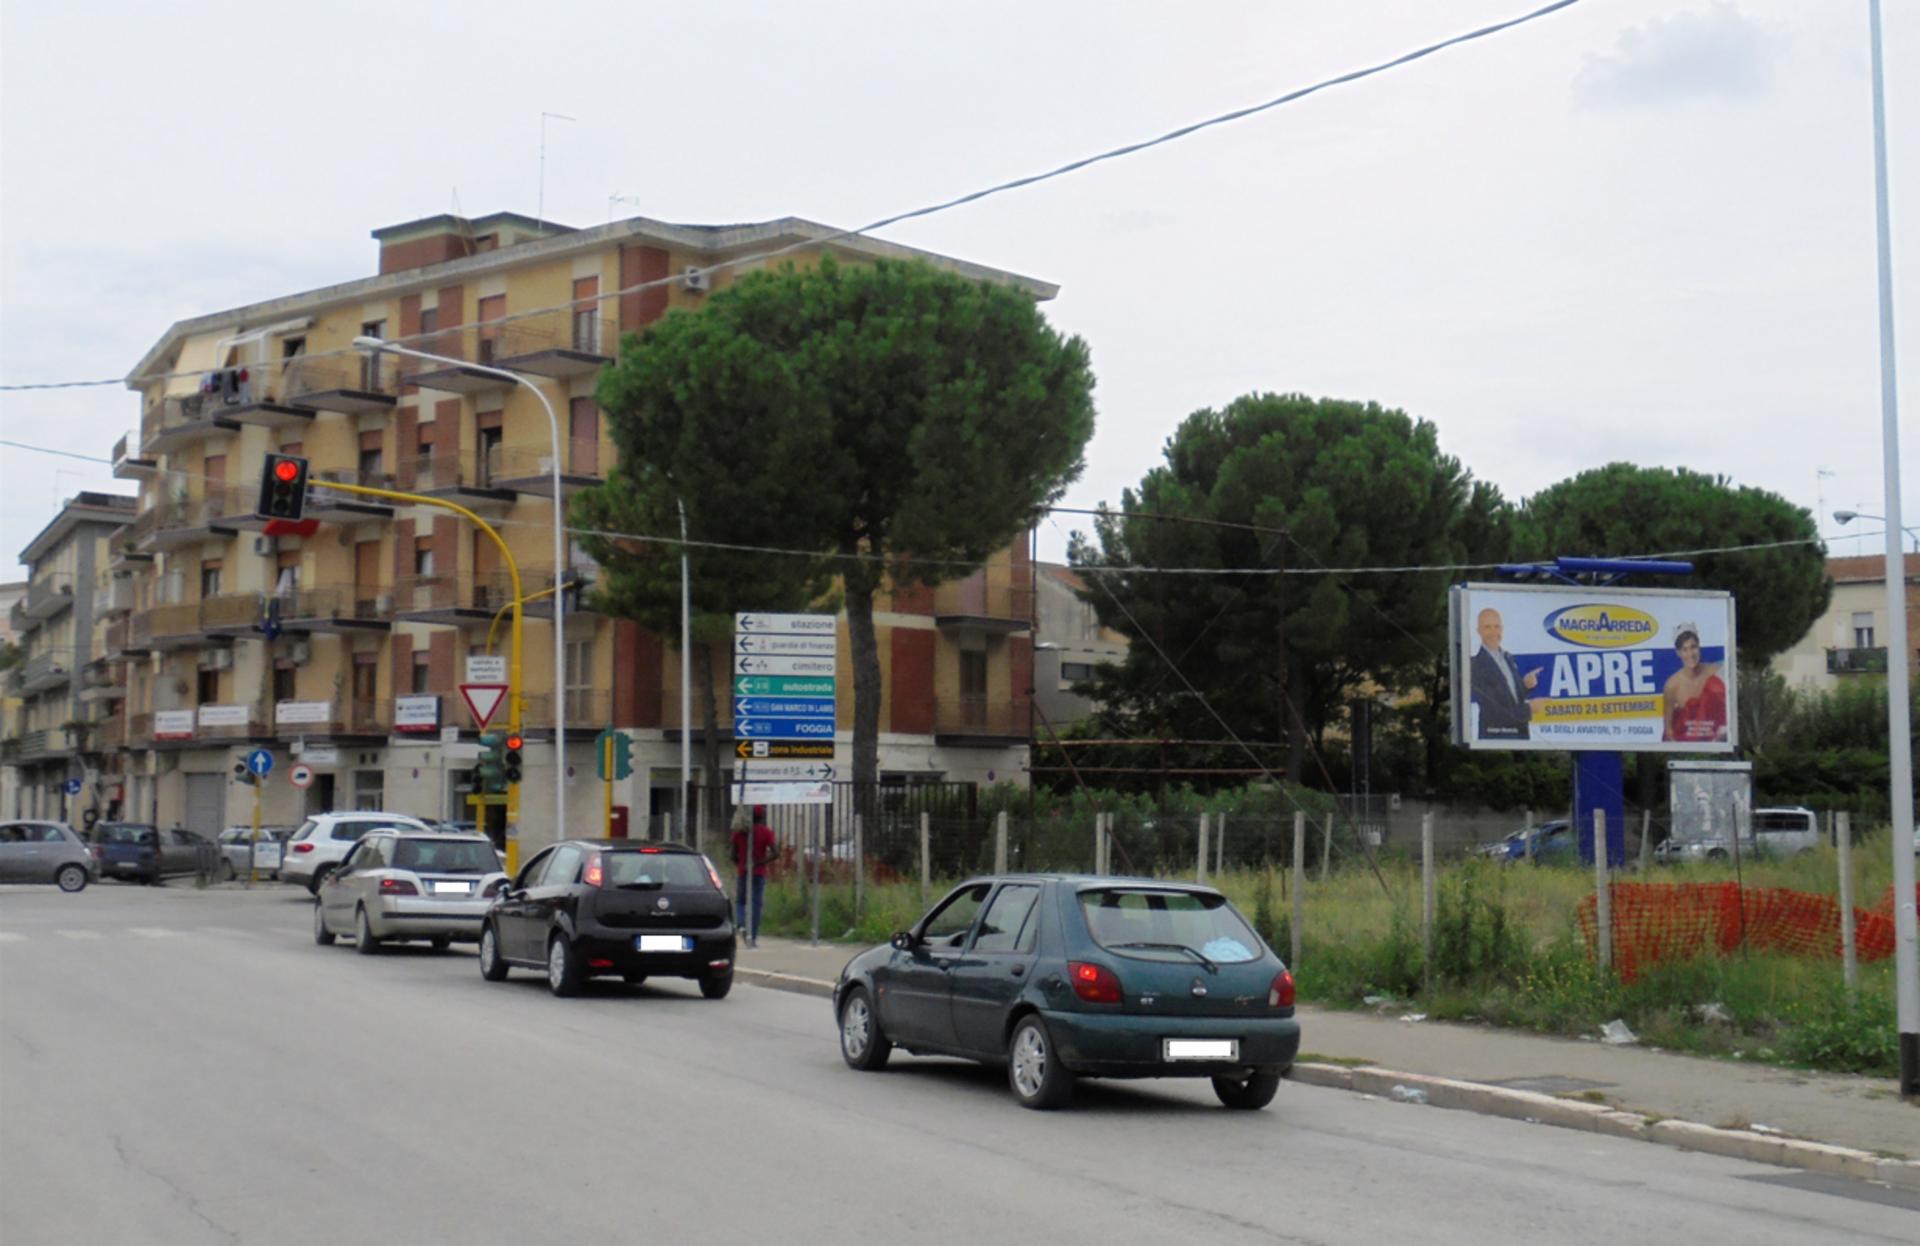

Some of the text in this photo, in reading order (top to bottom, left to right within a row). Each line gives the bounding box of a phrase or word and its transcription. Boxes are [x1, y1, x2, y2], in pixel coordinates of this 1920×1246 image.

[791, 620, 833, 629] stazione
[792, 662, 833, 671] cimitero
[1550, 650, 1656, 697] APRE
[782, 683, 833, 692] autostrada
[771, 703, 784, 712] SAN
[784, 703, 807, 712] MARCO
[1545, 700, 1656, 716] SABATO 24 SETTEMBRE
[795, 723, 833, 733] FOGGIA
[1540, 725, 1552, 733] VIA
[1554, 725, 1575, 734] DEGLI
[1628, 726, 1654, 735] FOGGIA
[769, 746, 789, 754] zona
